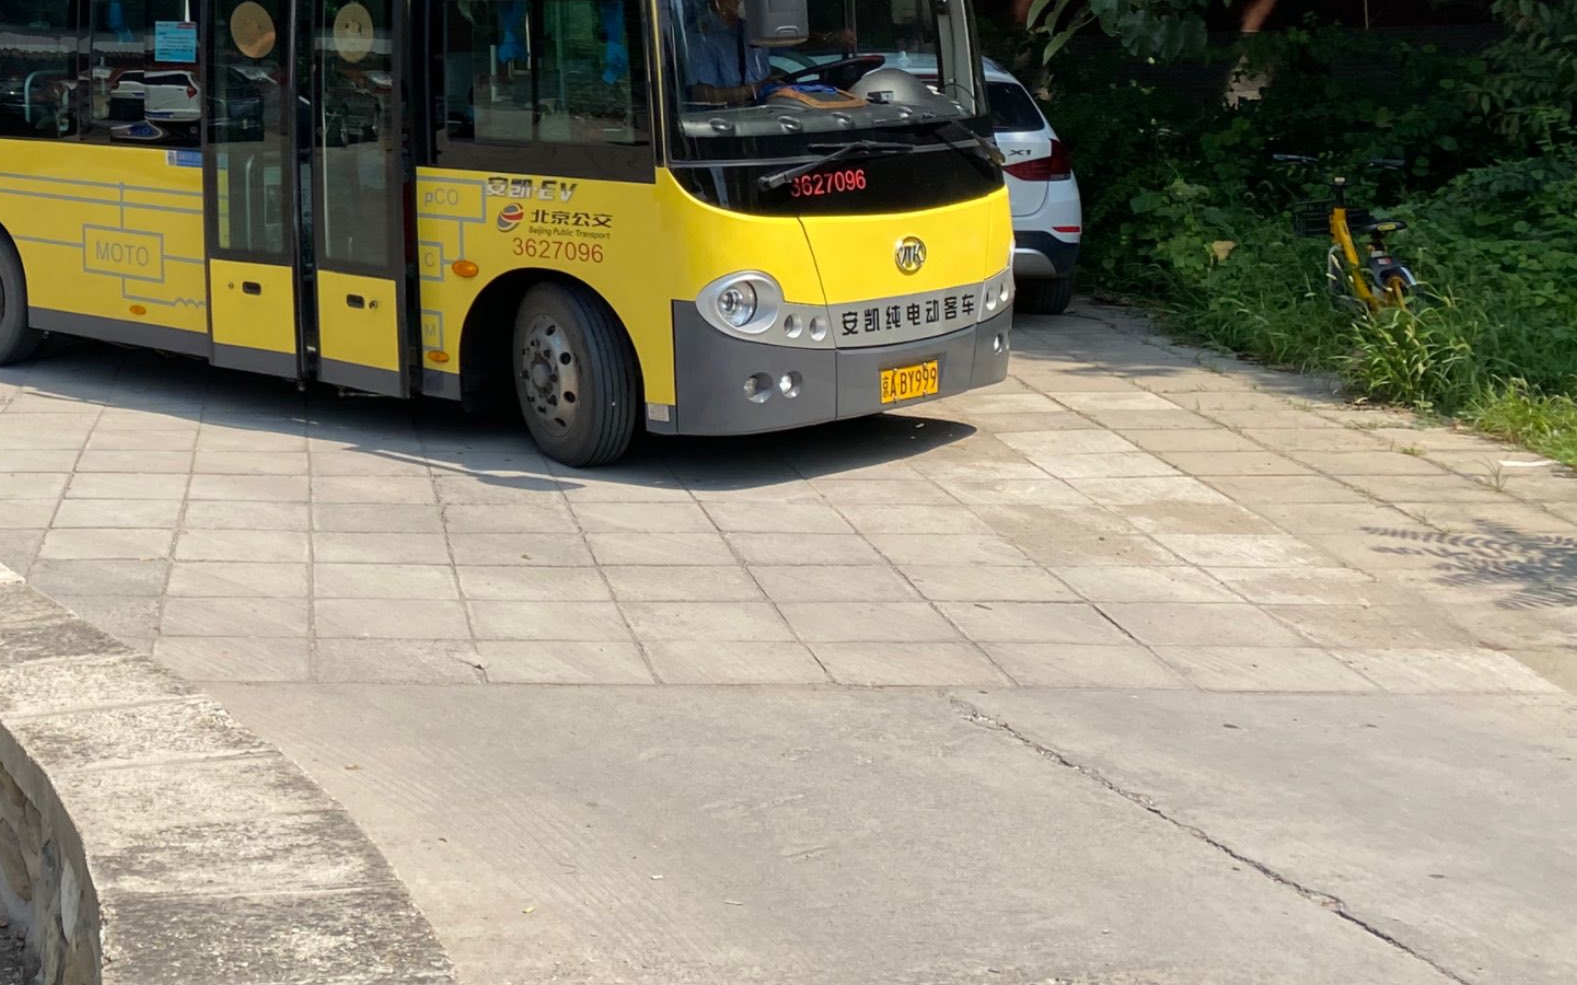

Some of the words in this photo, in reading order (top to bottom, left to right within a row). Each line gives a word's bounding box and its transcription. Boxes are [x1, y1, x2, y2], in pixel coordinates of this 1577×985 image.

[1007, 149, 1032, 157] X1
[530, 209, 613, 229] 北京公交
[529, 225, 551, 237] Beijing
[552, 227, 573, 237] Public
[575, 229, 611, 240] Transport
[95, 241, 150, 266] MOTO
[512, 237, 604, 264] 3627096
[842, 294, 974, 336] 安凯纯电动客车
